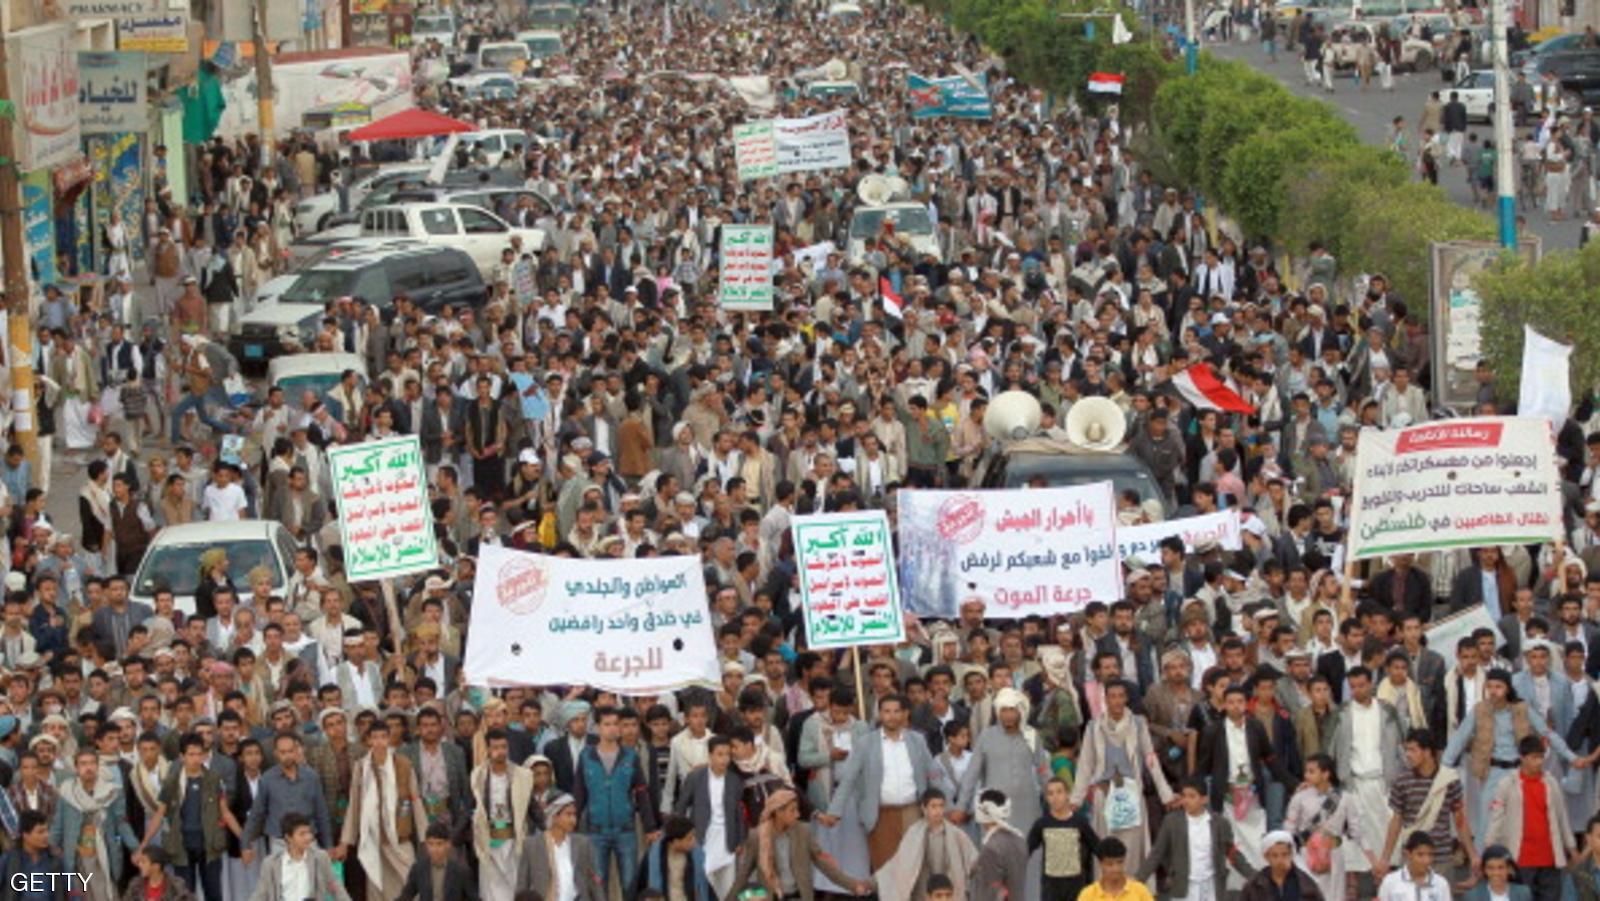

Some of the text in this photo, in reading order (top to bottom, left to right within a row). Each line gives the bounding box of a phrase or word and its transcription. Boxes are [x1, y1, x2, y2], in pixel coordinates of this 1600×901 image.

[387, 450, 416, 469] الله
[1472, 454, 1494, 469] من
[995, 507, 1042, 532] الجيش
[1428, 514, 1450, 532] في
[854, 527, 884, 546] الله
[961, 549, 1002, 573] لرفض
[1006, 548, 1057, 572] شعبكم
[1061, 553, 1081, 570] مع
[994, 584, 1092, 610] جرعة الموت
[548, 614, 604, 635] رافضين
[606, 614, 639, 632] واحد
[680, 610, 703, 628] في
[594, 646, 663, 678] للجرعة
